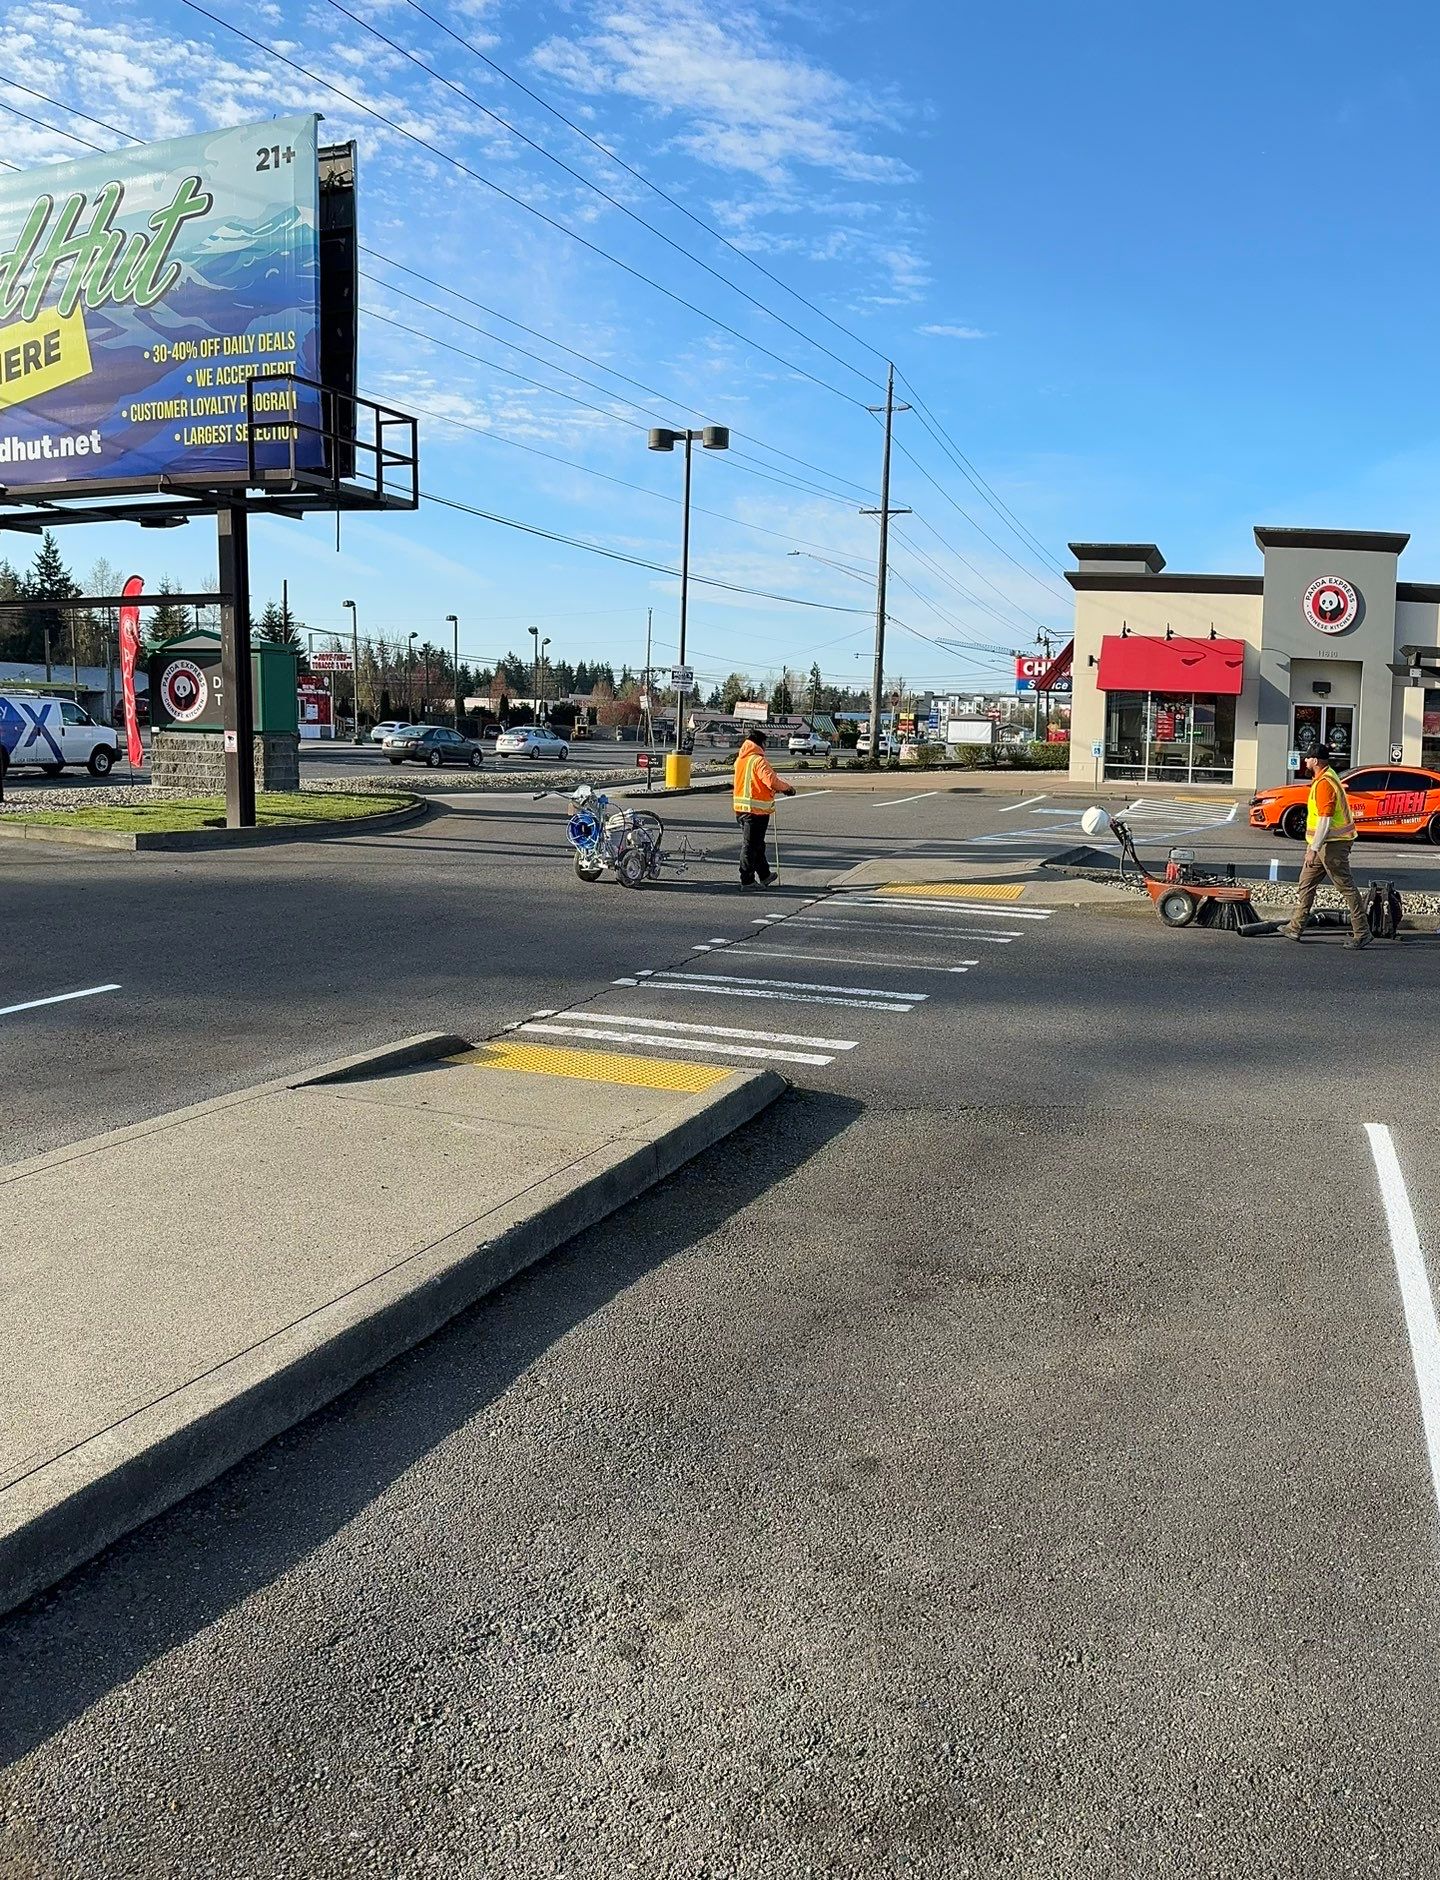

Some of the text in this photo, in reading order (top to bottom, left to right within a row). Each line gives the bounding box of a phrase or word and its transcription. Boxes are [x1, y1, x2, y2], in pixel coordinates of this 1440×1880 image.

[255, 144, 296, 172] 21+
[0, 329, 61, 385] ERE
[153, 330, 296, 363] 30-40% OFF DAILY DEALS
[196, 368, 213, 387] WE
[216, 364, 259, 385] ACCEPT
[130, 397, 188, 422] CUSTOMER
[190, 395, 237, 417] LOYALTY
[183, 424, 233, 446] LARGEST
[1305, 577, 1356, 604] PANDA EXPRESS
[1306, 610, 1353, 630] CHINESE KITCHEN
[162, 661, 206, 688] PANDA EXPRESS
[1027, 679, 1069, 690] Sice
[164, 698, 184, 719] CHINESE
[1376, 790, 1427, 816] JIREH
